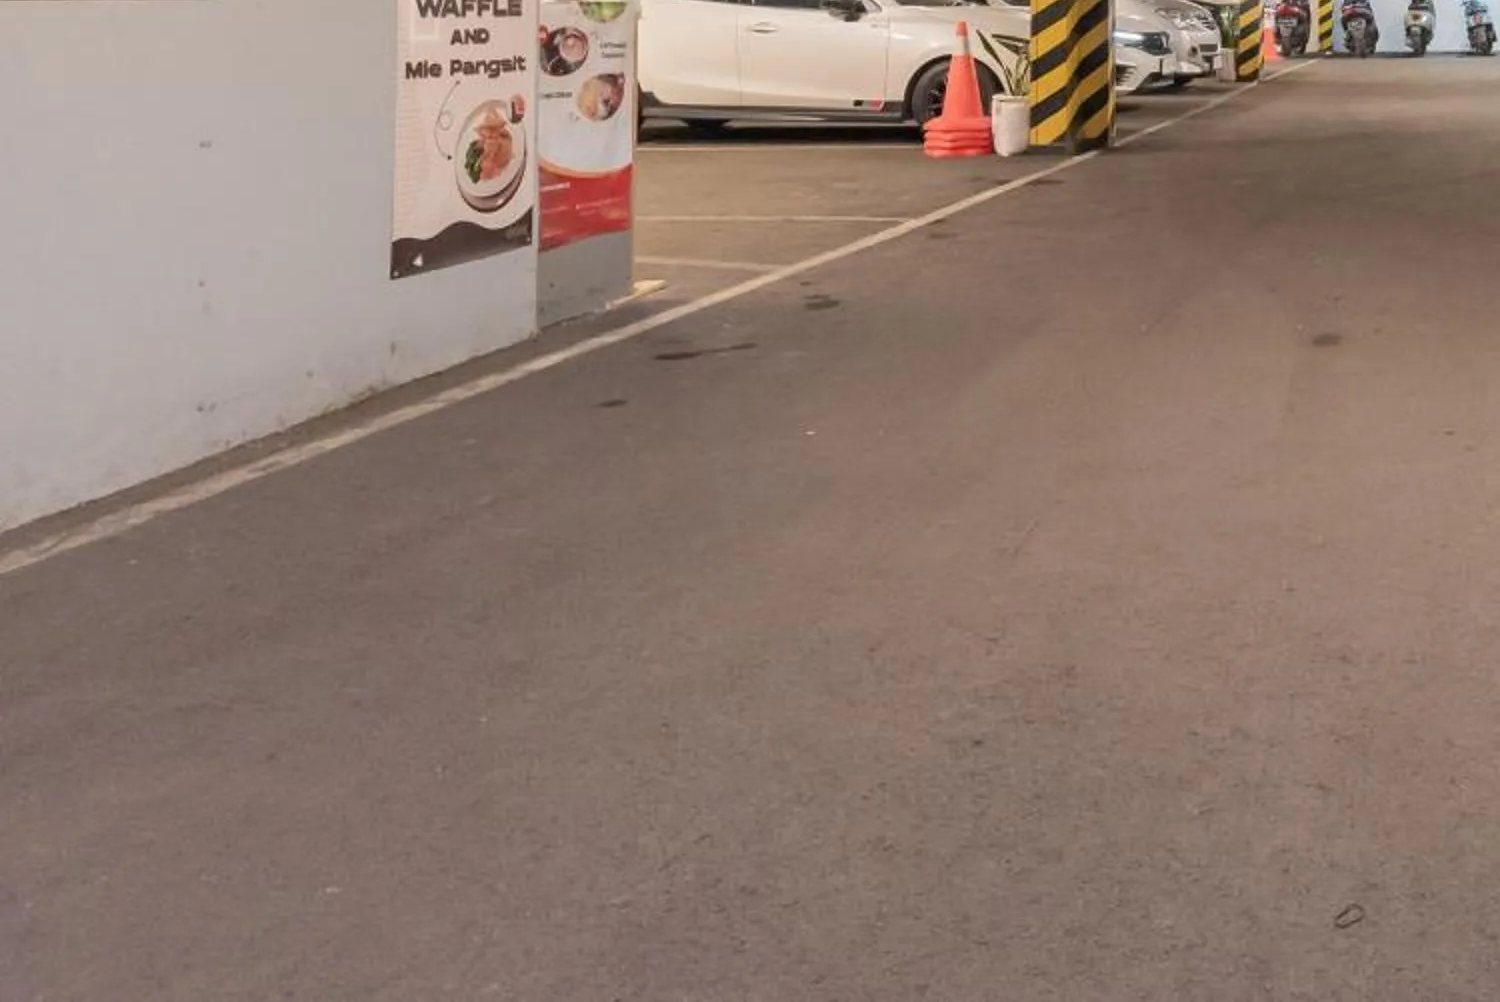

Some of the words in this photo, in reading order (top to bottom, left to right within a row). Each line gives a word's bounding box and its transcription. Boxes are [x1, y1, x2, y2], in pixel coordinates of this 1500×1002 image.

[449, 27, 490, 46] AND
[405, 60, 443, 80] Mie
[449, 55, 527, 79] Pangsit
